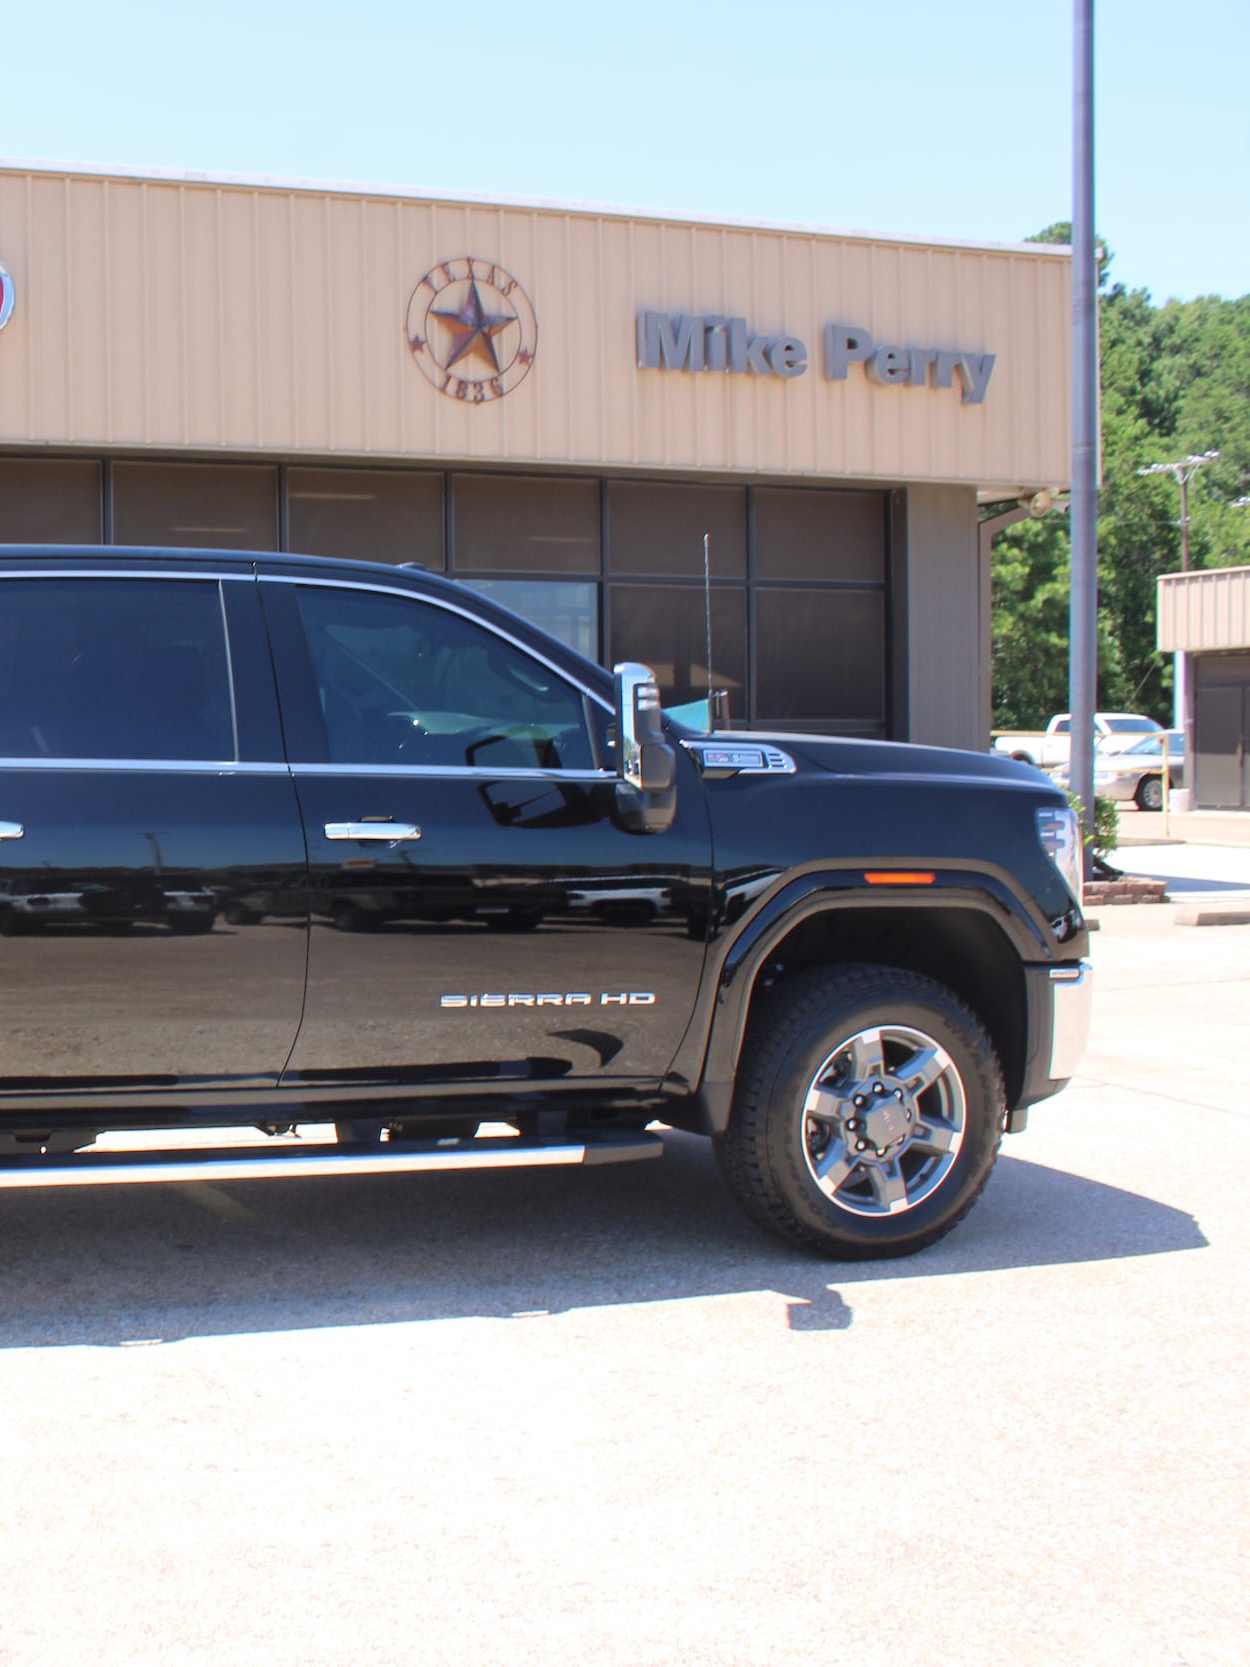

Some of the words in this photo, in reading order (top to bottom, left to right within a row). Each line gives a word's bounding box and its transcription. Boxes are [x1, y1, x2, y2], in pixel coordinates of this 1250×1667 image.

[636, 310, 808, 379] Mike
[823, 323, 997, 405] Perry
[439, 374, 505, 406] 1836
[440, 993, 592, 1008] SIERRA
[600, 992, 656, 1006] HD
